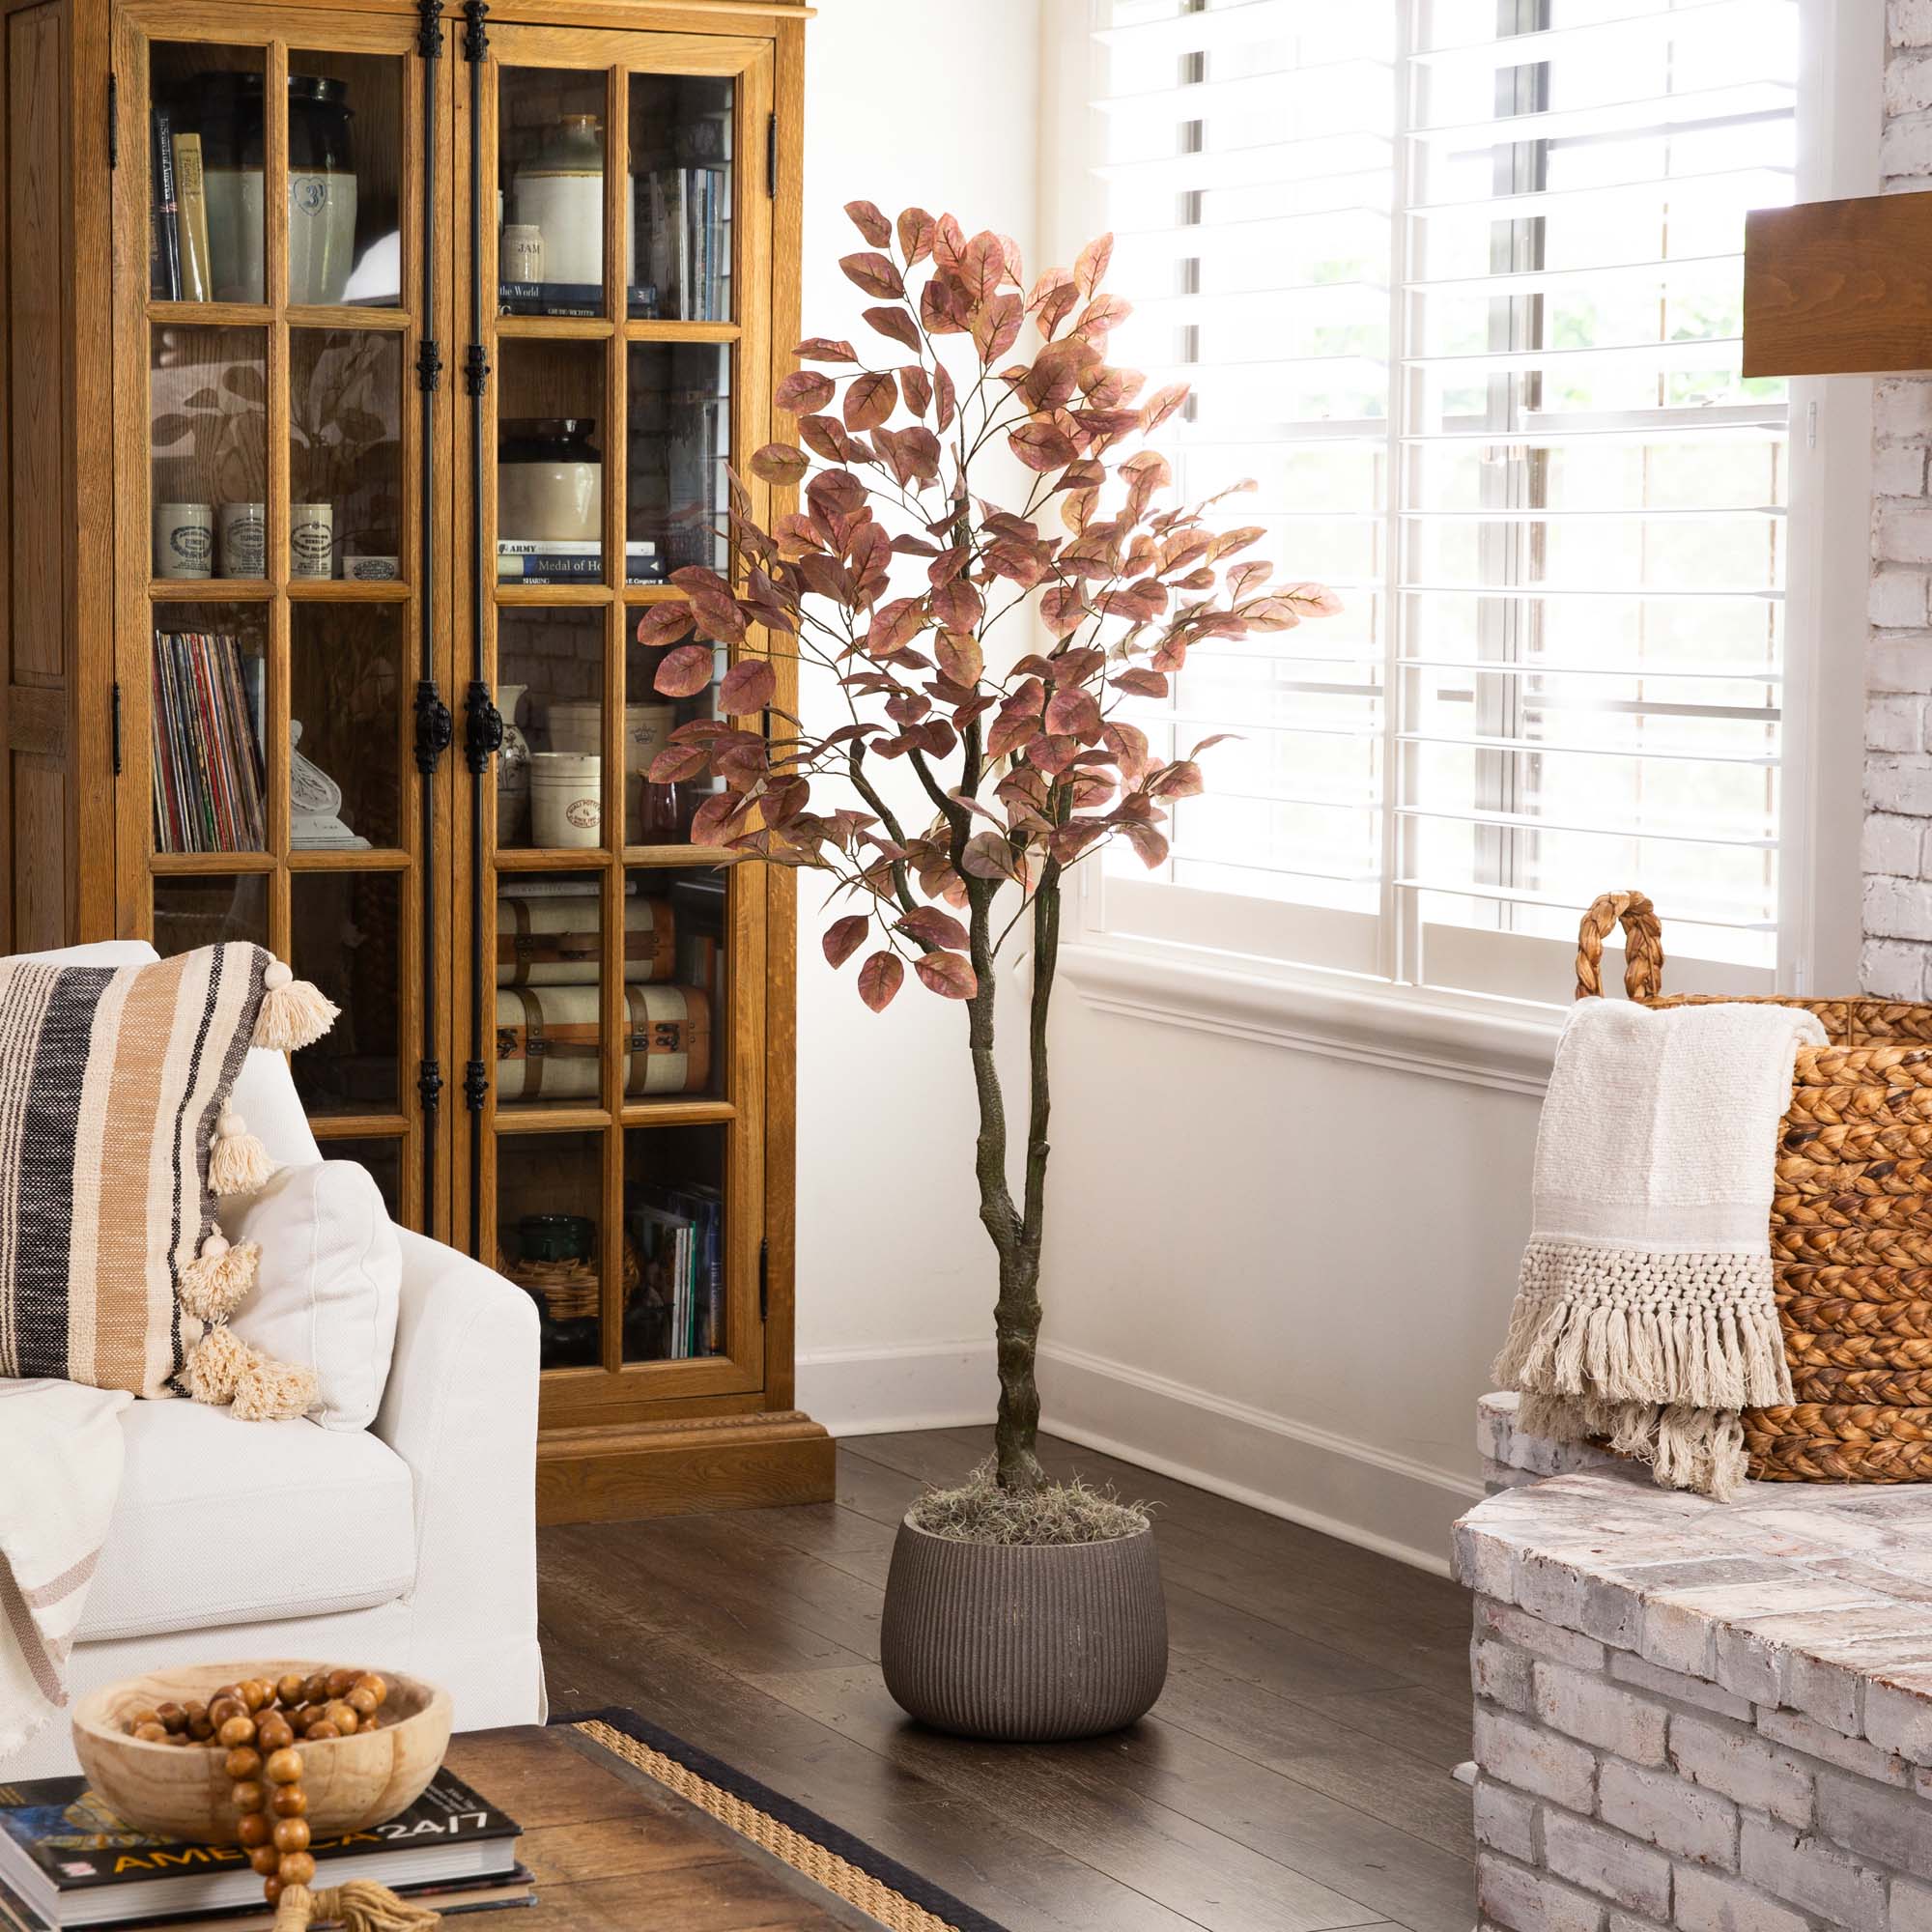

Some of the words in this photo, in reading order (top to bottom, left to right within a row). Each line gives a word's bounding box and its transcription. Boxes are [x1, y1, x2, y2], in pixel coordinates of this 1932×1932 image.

[163, 164, 172, 200] America
[518, 243, 540, 254] JAM
[514, 286, 539, 297] World
[538, 560, 571, 571] Medal
[574, 559, 584, 571] of
